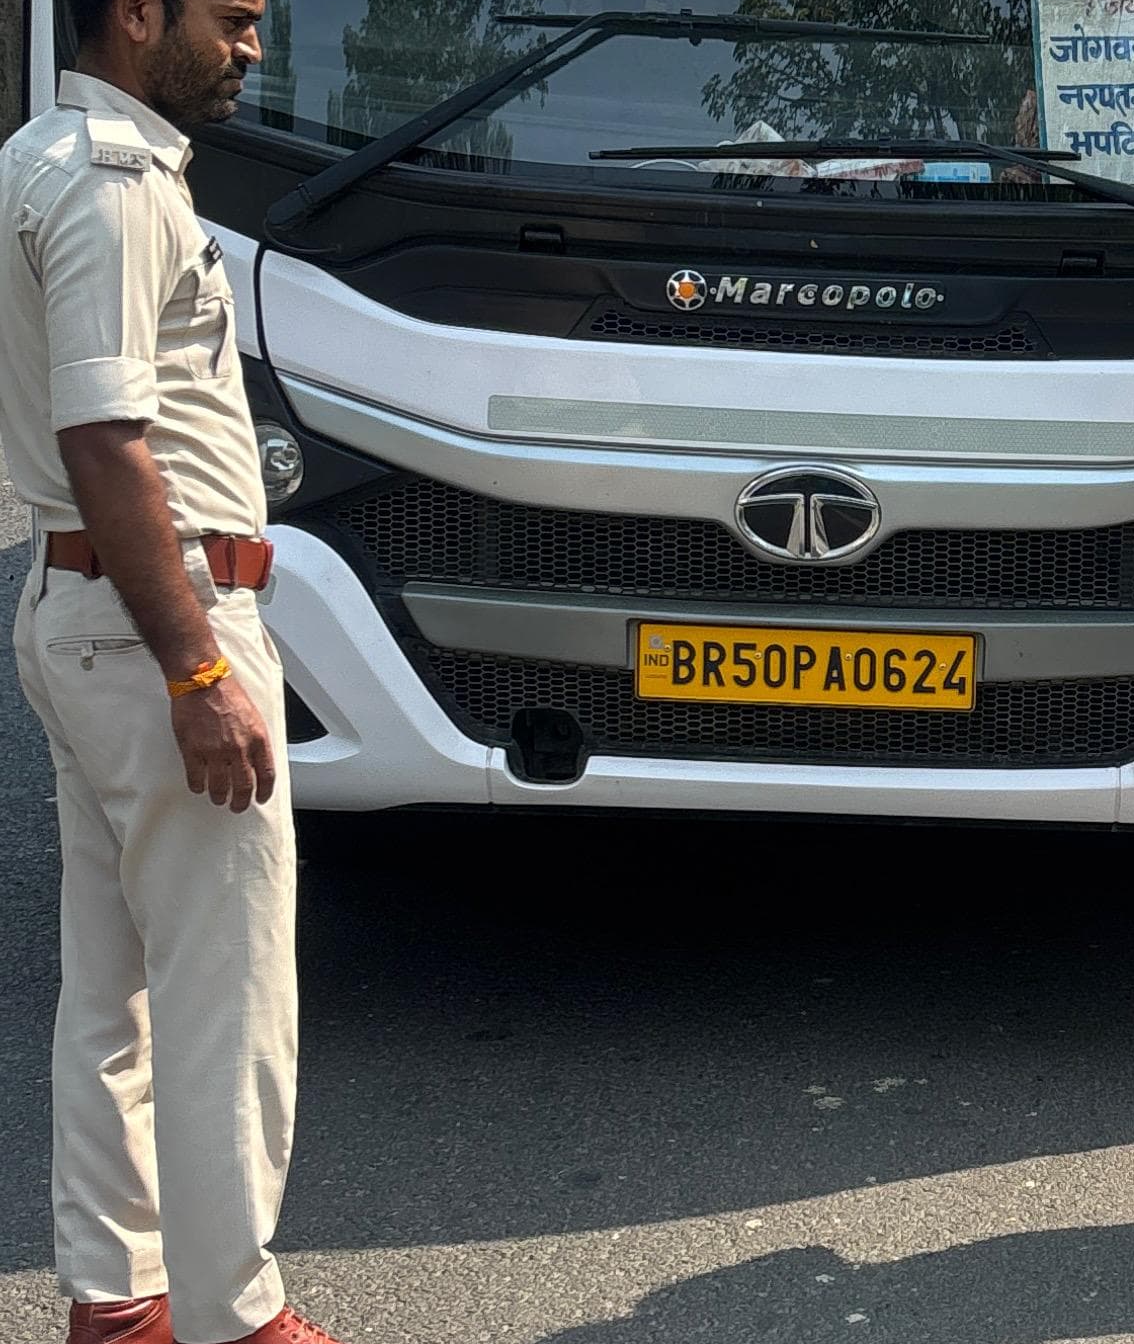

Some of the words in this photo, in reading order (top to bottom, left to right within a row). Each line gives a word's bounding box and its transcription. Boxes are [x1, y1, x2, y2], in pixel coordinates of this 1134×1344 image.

[713, 275, 938, 310] Marcopolo
[643, 653, 670, 668] IND
[671, 639, 968, 697] BR50PA0624
